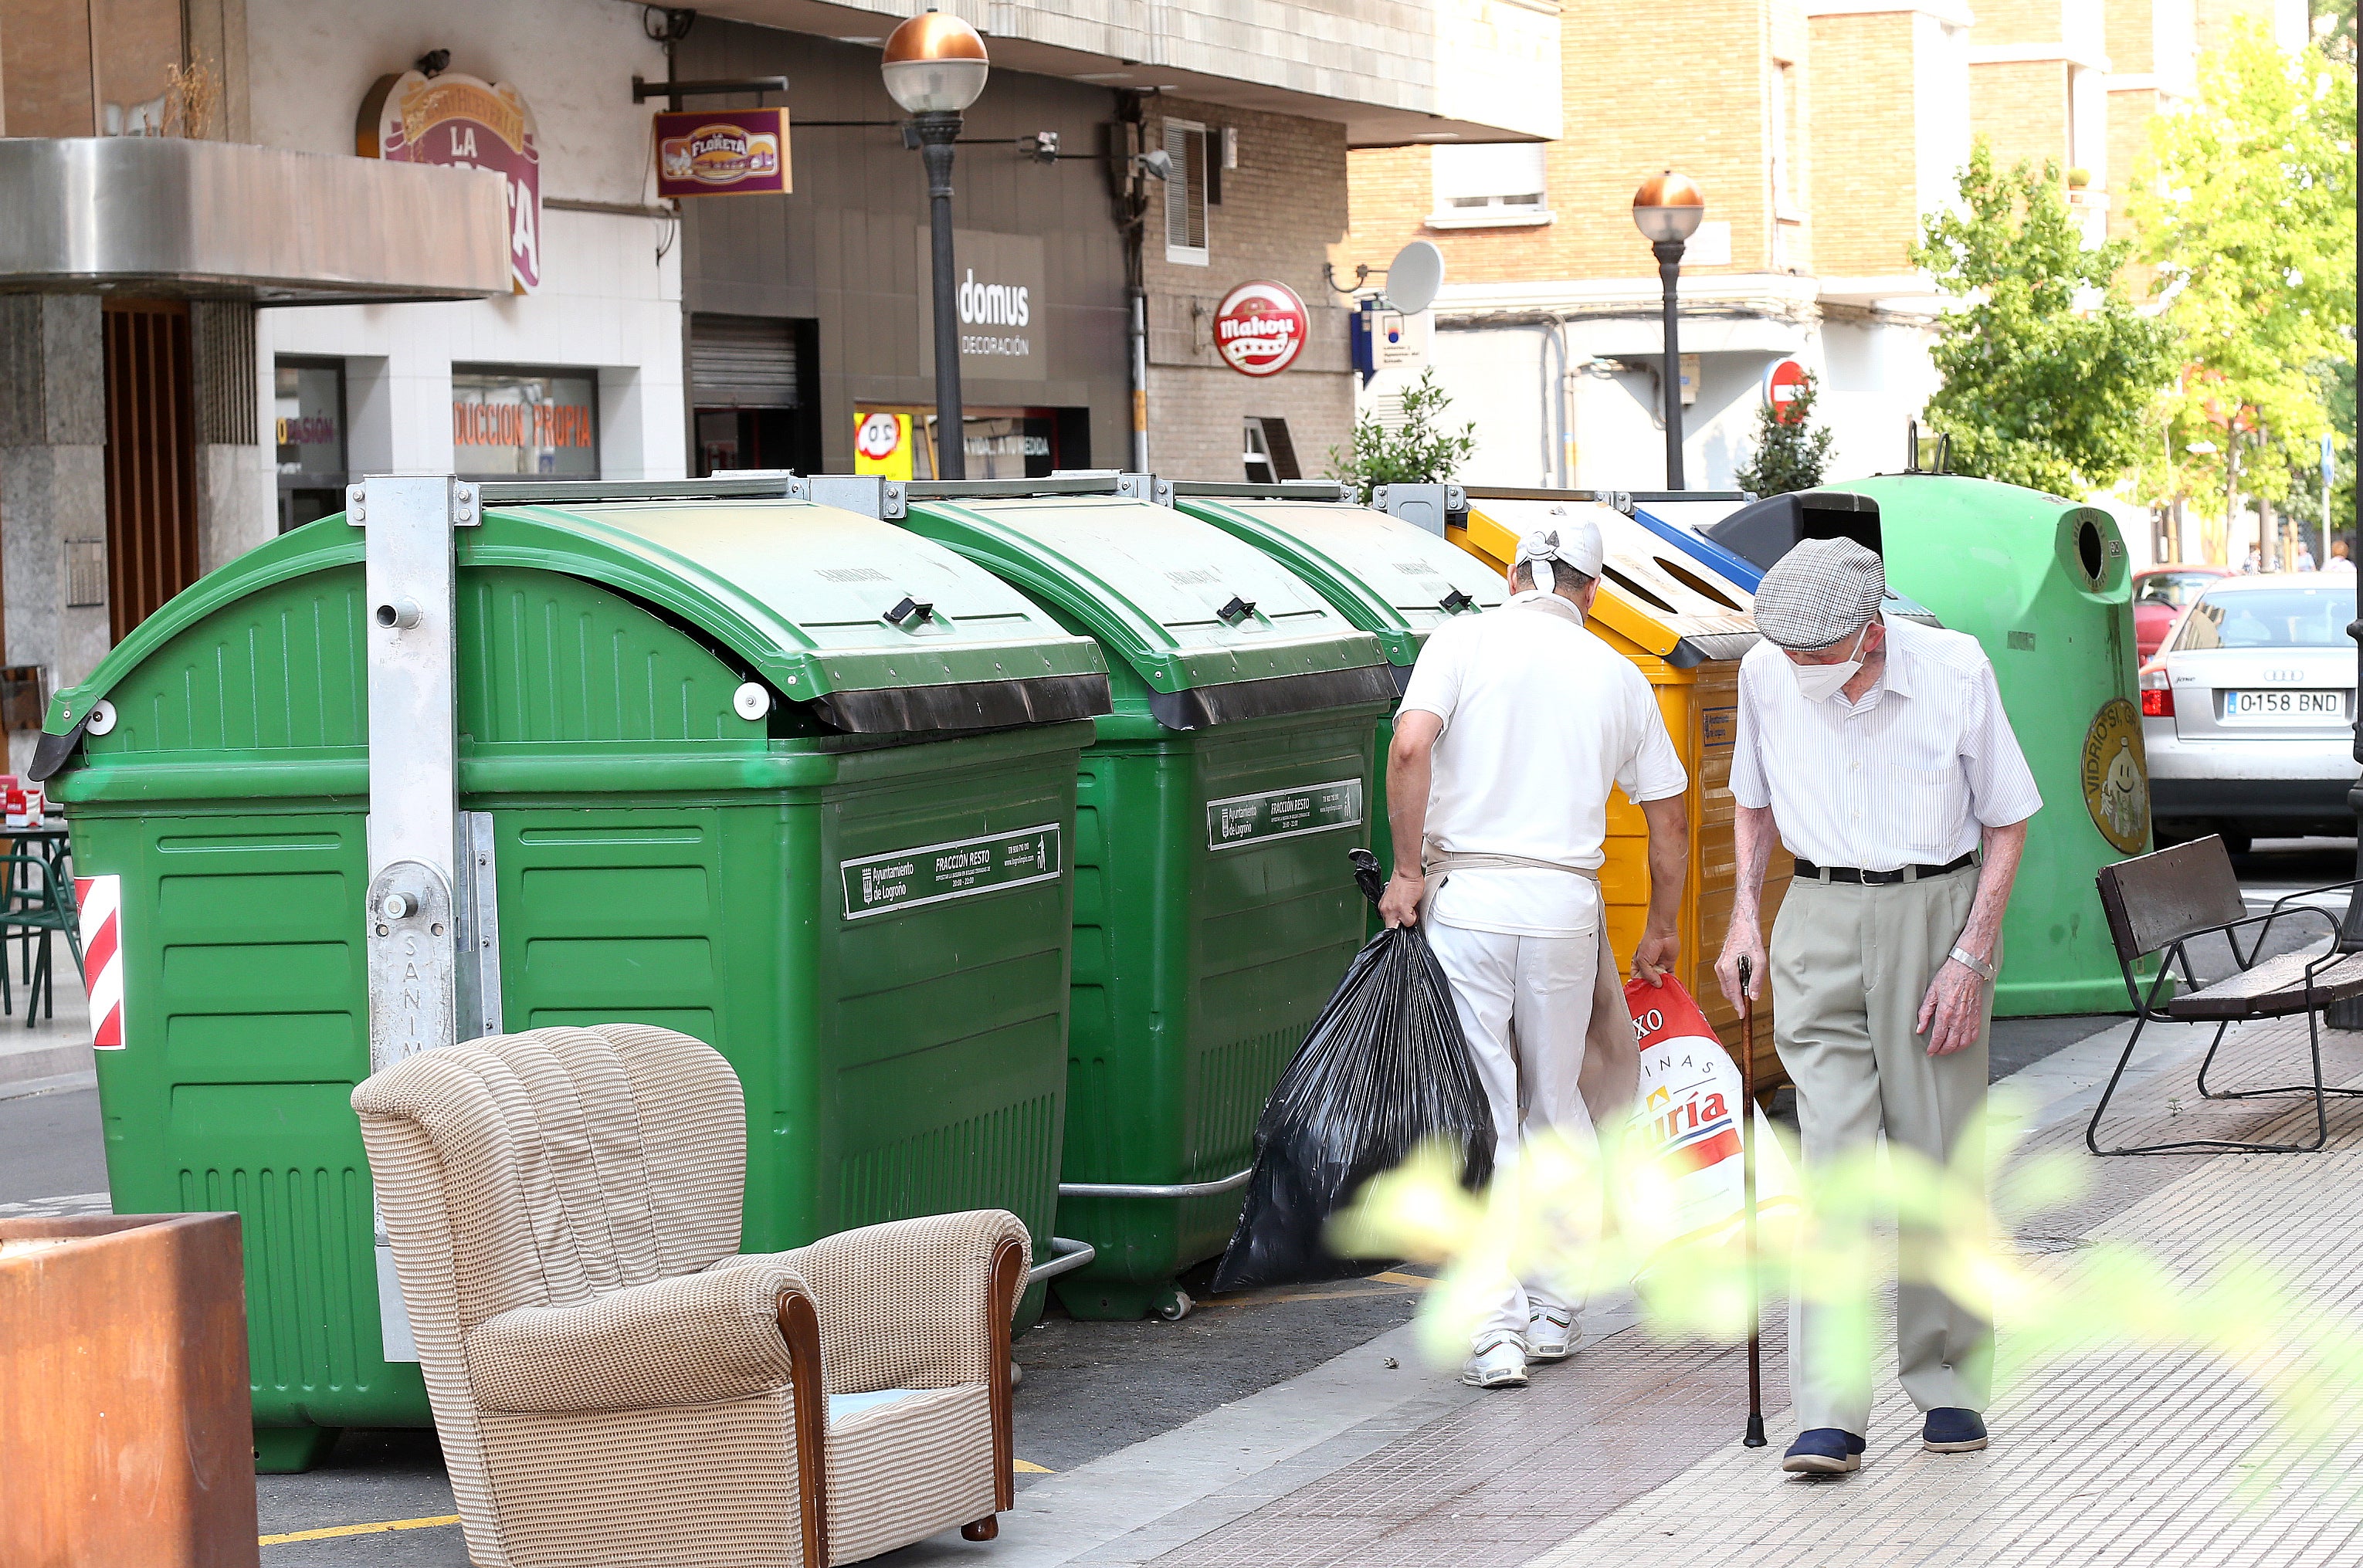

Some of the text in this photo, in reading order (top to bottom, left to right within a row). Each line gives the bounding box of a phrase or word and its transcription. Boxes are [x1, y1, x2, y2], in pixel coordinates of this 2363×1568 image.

[450, 126, 478, 158] LA
[691, 137, 748, 157] FLORETA
[958, 268, 1029, 327] domus
[1219, 315, 1295, 340] Mahou
[961, 334, 1030, 357] DECORACIÓN
[533, 404, 592, 448] PROPIA
[2299, 694, 2337, 712] BND
[2087, 722, 2108, 795] VIDRIO
[1229, 804, 1257, 823] Ayuntamiento
[1270, 797, 1294, 815] FRACCIÓN
[1294, 798, 1310, 811] RESTO
[1229, 821, 1252, 838] de Logroño
[935, 849, 968, 872] FRACCIÓN
[969, 849, 990, 866] RESTO
[873, 862, 914, 886] Ayuntamiento
[873, 881, 907, 902] de Logroño
[1645, 1054, 1714, 1078] INAS
[1622, 1091, 1729, 1152] uría
